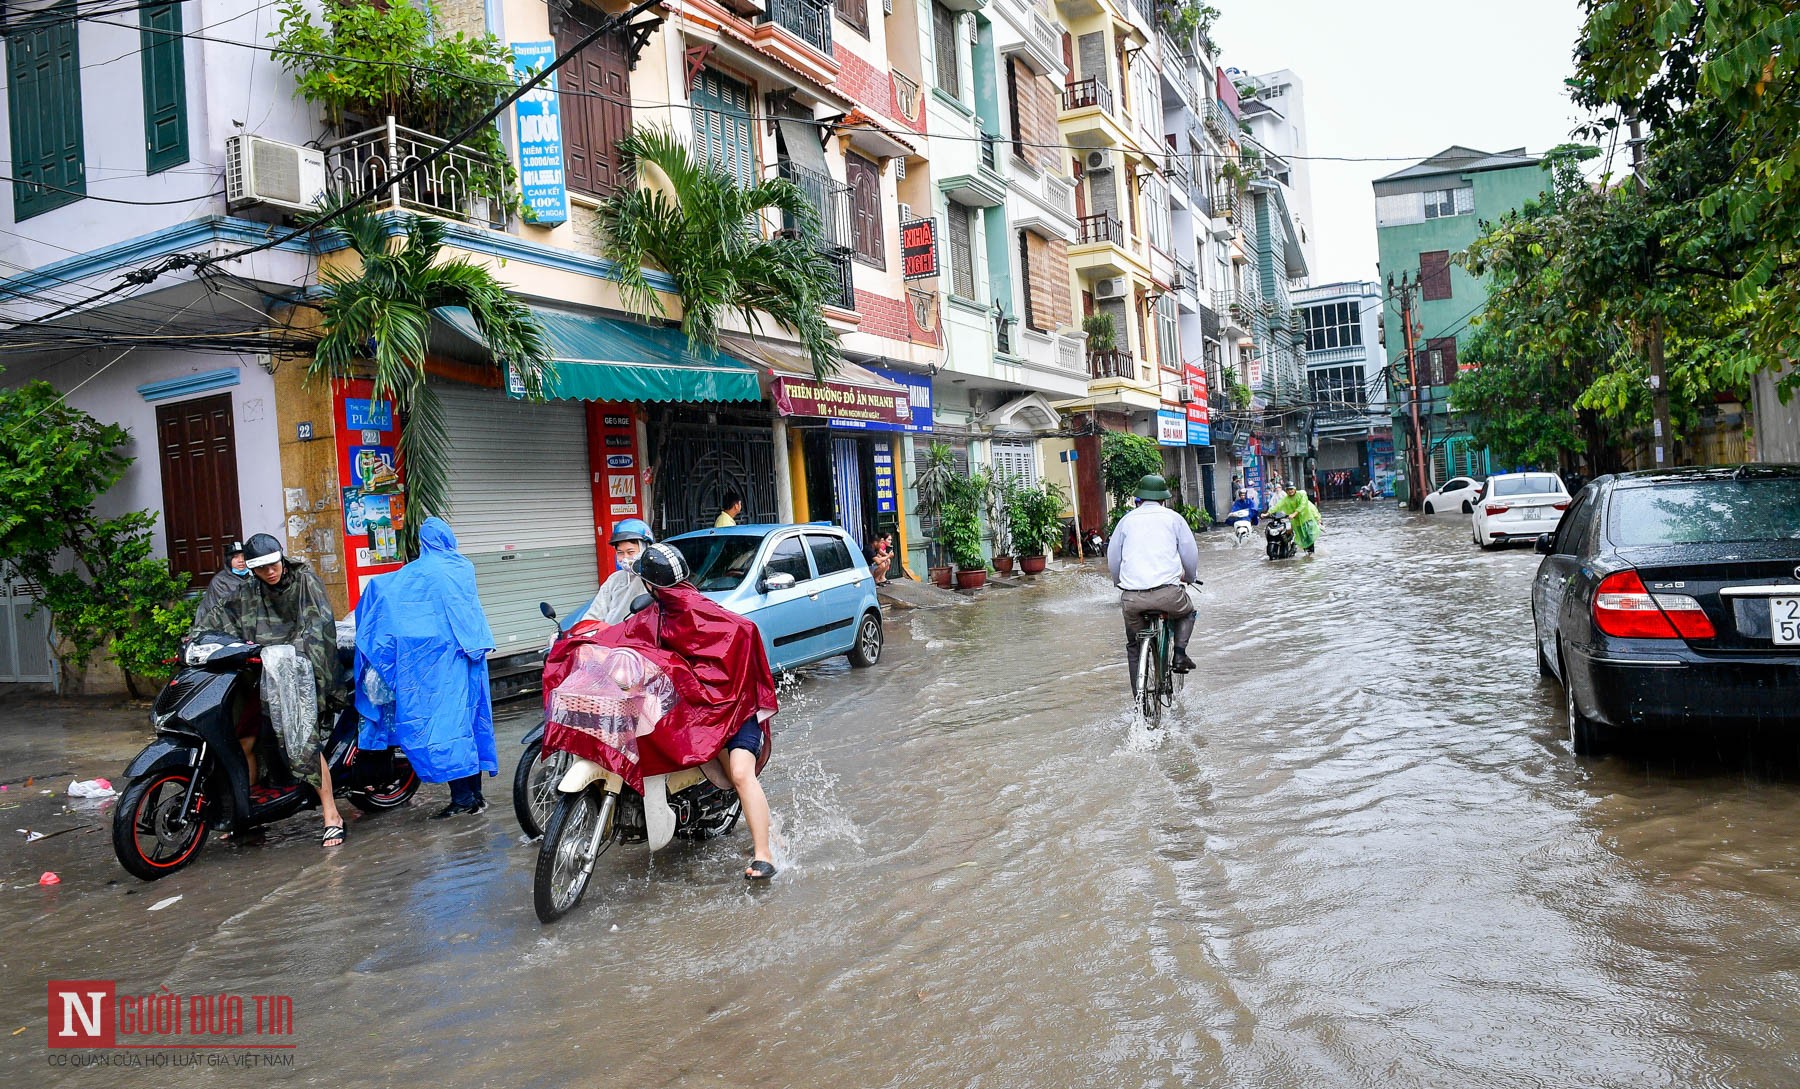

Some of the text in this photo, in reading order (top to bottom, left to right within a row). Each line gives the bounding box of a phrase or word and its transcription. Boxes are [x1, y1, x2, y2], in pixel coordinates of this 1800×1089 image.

[522, 143, 558, 155] NIÊM YẾT
[547, 187, 559, 196] KẾT
[531, 197, 560, 208] 100%
[904, 222, 932, 248] NHÀ
[904, 247, 934, 276] NGHỈ
[785, 382, 812, 400] THIÊN
[814, 383, 843, 403] ĐƯỜNG
[843, 386, 856, 405] ĐỒ
[857, 389, 868, 406] ĂN
[868, 394, 894, 409] NHANH
[909, 385, 930, 408] MINH
[817, 403, 827, 416] 100
[352, 414, 389, 426] PLACE
[299, 424, 311, 438] 22
[365, 431, 378, 443] 22
